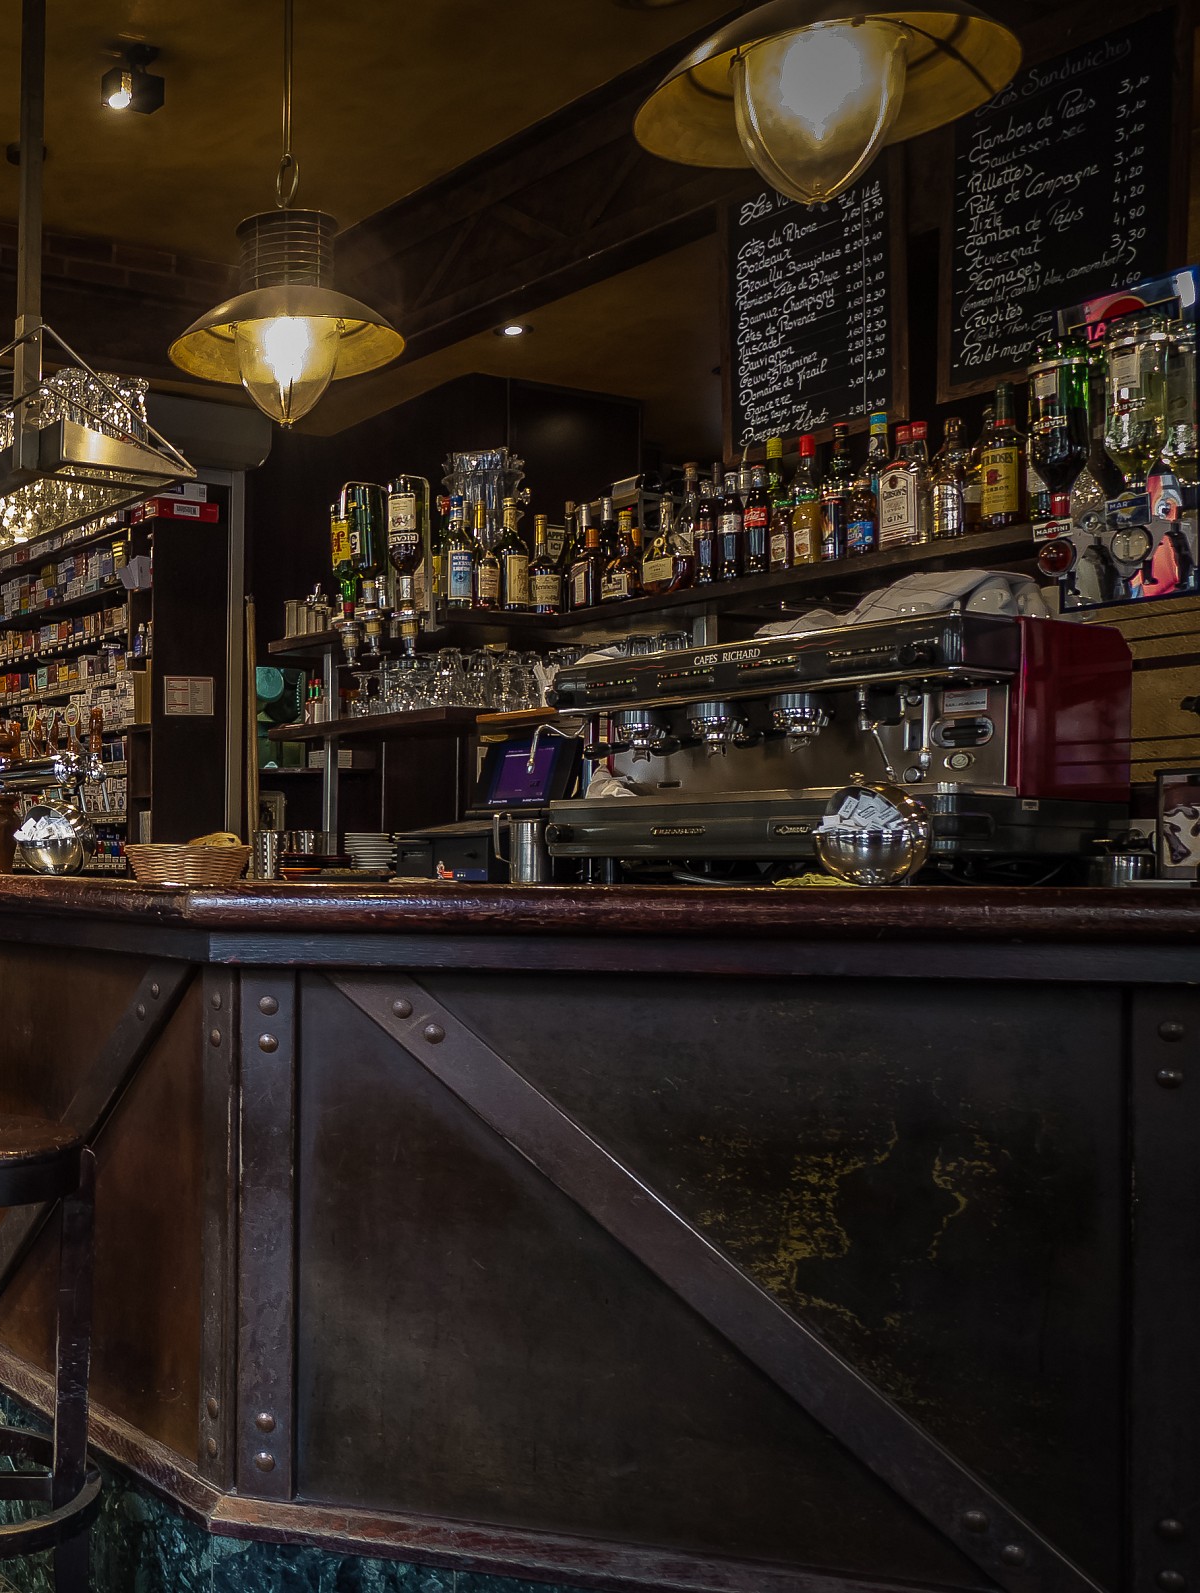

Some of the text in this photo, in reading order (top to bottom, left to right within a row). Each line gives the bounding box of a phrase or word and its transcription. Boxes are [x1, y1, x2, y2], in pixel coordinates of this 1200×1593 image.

[976, 38, 1133, 118] Les Sandwiches
[968, 75, 1151, 163] Jambon de Paris 3,10
[972, 99, 1147, 176] Saucisson sec 3,10
[967, 123, 1145, 194] Rillettes 3,10
[1004, 183, 1020, 204] de
[1024, 163, 1100, 199] Campagne
[1113, 146, 1145, 167] 3,10
[1114, 165, 1143, 184] 4,20
[739, 192, 773, 226] Les
[964, 184, 1145, 257] Jambon de Pays 4,20
[736, 211, 885, 280] Bordeaux 2,00 3,10
[767, 230, 783, 248] du
[842, 207, 861, 222] 1,60
[736, 266, 784, 298] Brouilly
[785, 248, 842, 277] Beaujolais
[864, 232, 883, 247] 3,40
[964, 227, 1147, 293] Fromages 3,30
[966, 234, 1047, 272] Auvergnat
[797, 277, 808, 291] de
[808, 269, 841, 291] Blaye
[864, 252, 884, 268] 3,40
[846, 281, 863, 293] 2,00
[866, 271, 885, 286] 3,10
[964, 271, 1141, 331] Crudités 4,60
[765, 322, 778, 337] de
[777, 311, 818, 333] Provence
[865, 333, 886, 347] 3,40
[738, 332, 786, 361] Muscadet
[738, 346, 795, 376] Sauvignon
[960, 342, 999, 366] Poulet
[999, 340, 1036, 363] mayo
[739, 382, 782, 406] Domaine
[782, 374, 795, 390] de
[744, 394, 793, 421] Sancerre
[739, 423, 791, 448] Bourgogne
[866, 398, 886, 412] 3,40
[887, 515, 904, 524] GIN
[1036, 524, 1069, 535] MARTINI
[550, 542, 562, 551] ICI
[722, 648, 761, 662] RICHARD
